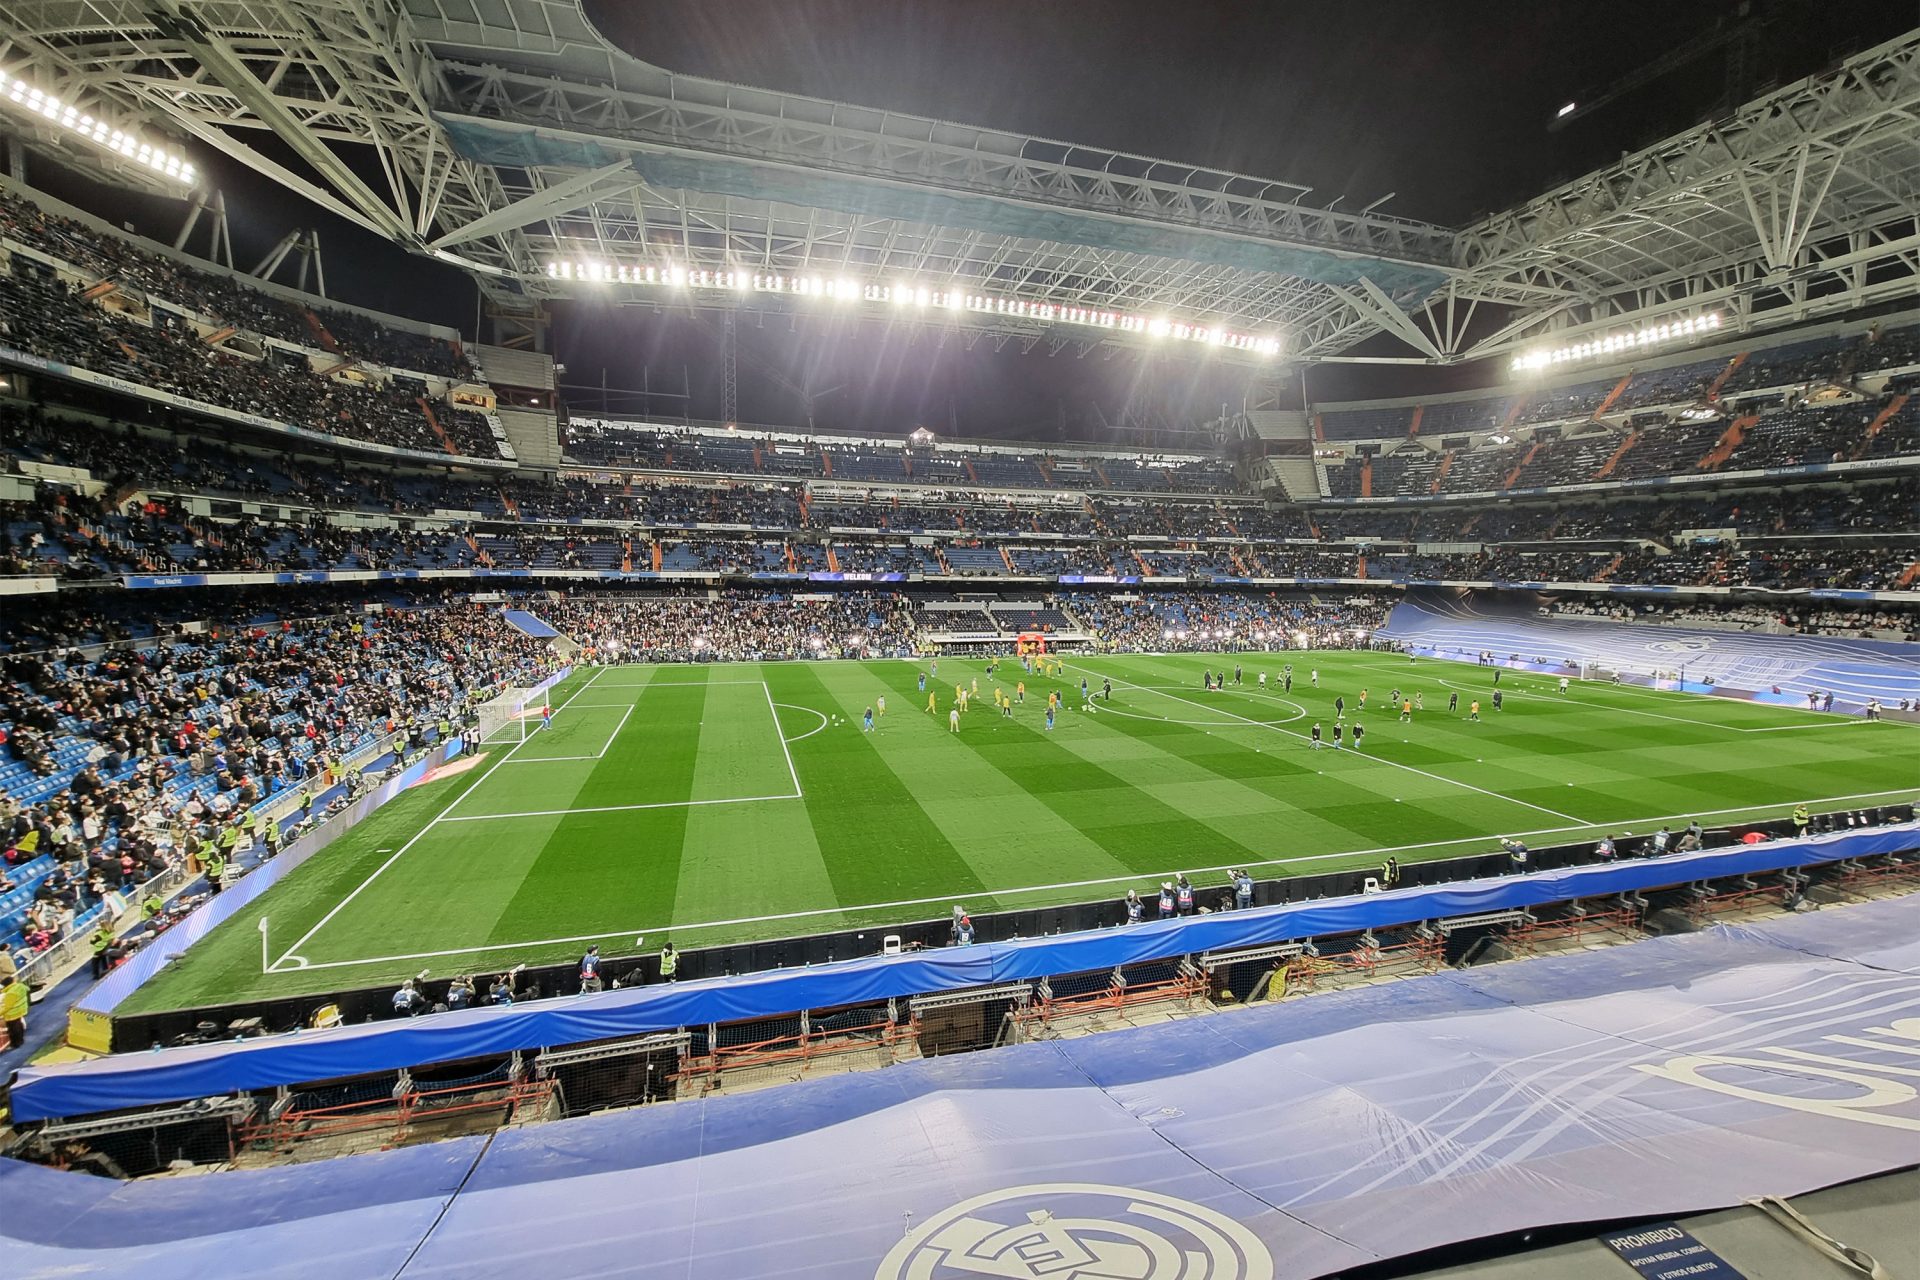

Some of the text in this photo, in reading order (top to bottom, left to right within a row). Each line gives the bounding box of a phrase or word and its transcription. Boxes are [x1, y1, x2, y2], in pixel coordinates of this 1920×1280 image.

[93, 375, 137, 394] Real Madrid
[1870, 459, 1899, 468] Madrid
[1781, 466, 1806, 474] Madrid
[843, 573, 872, 581] WELKOM
[1609, 1226, 1684, 1251] PROHIBIDO
[1630, 1255, 1657, 1267] APOYAR
[1664, 1268, 1689, 1280] OTROS
[1686, 1262, 1719, 1275] OBJETOS
